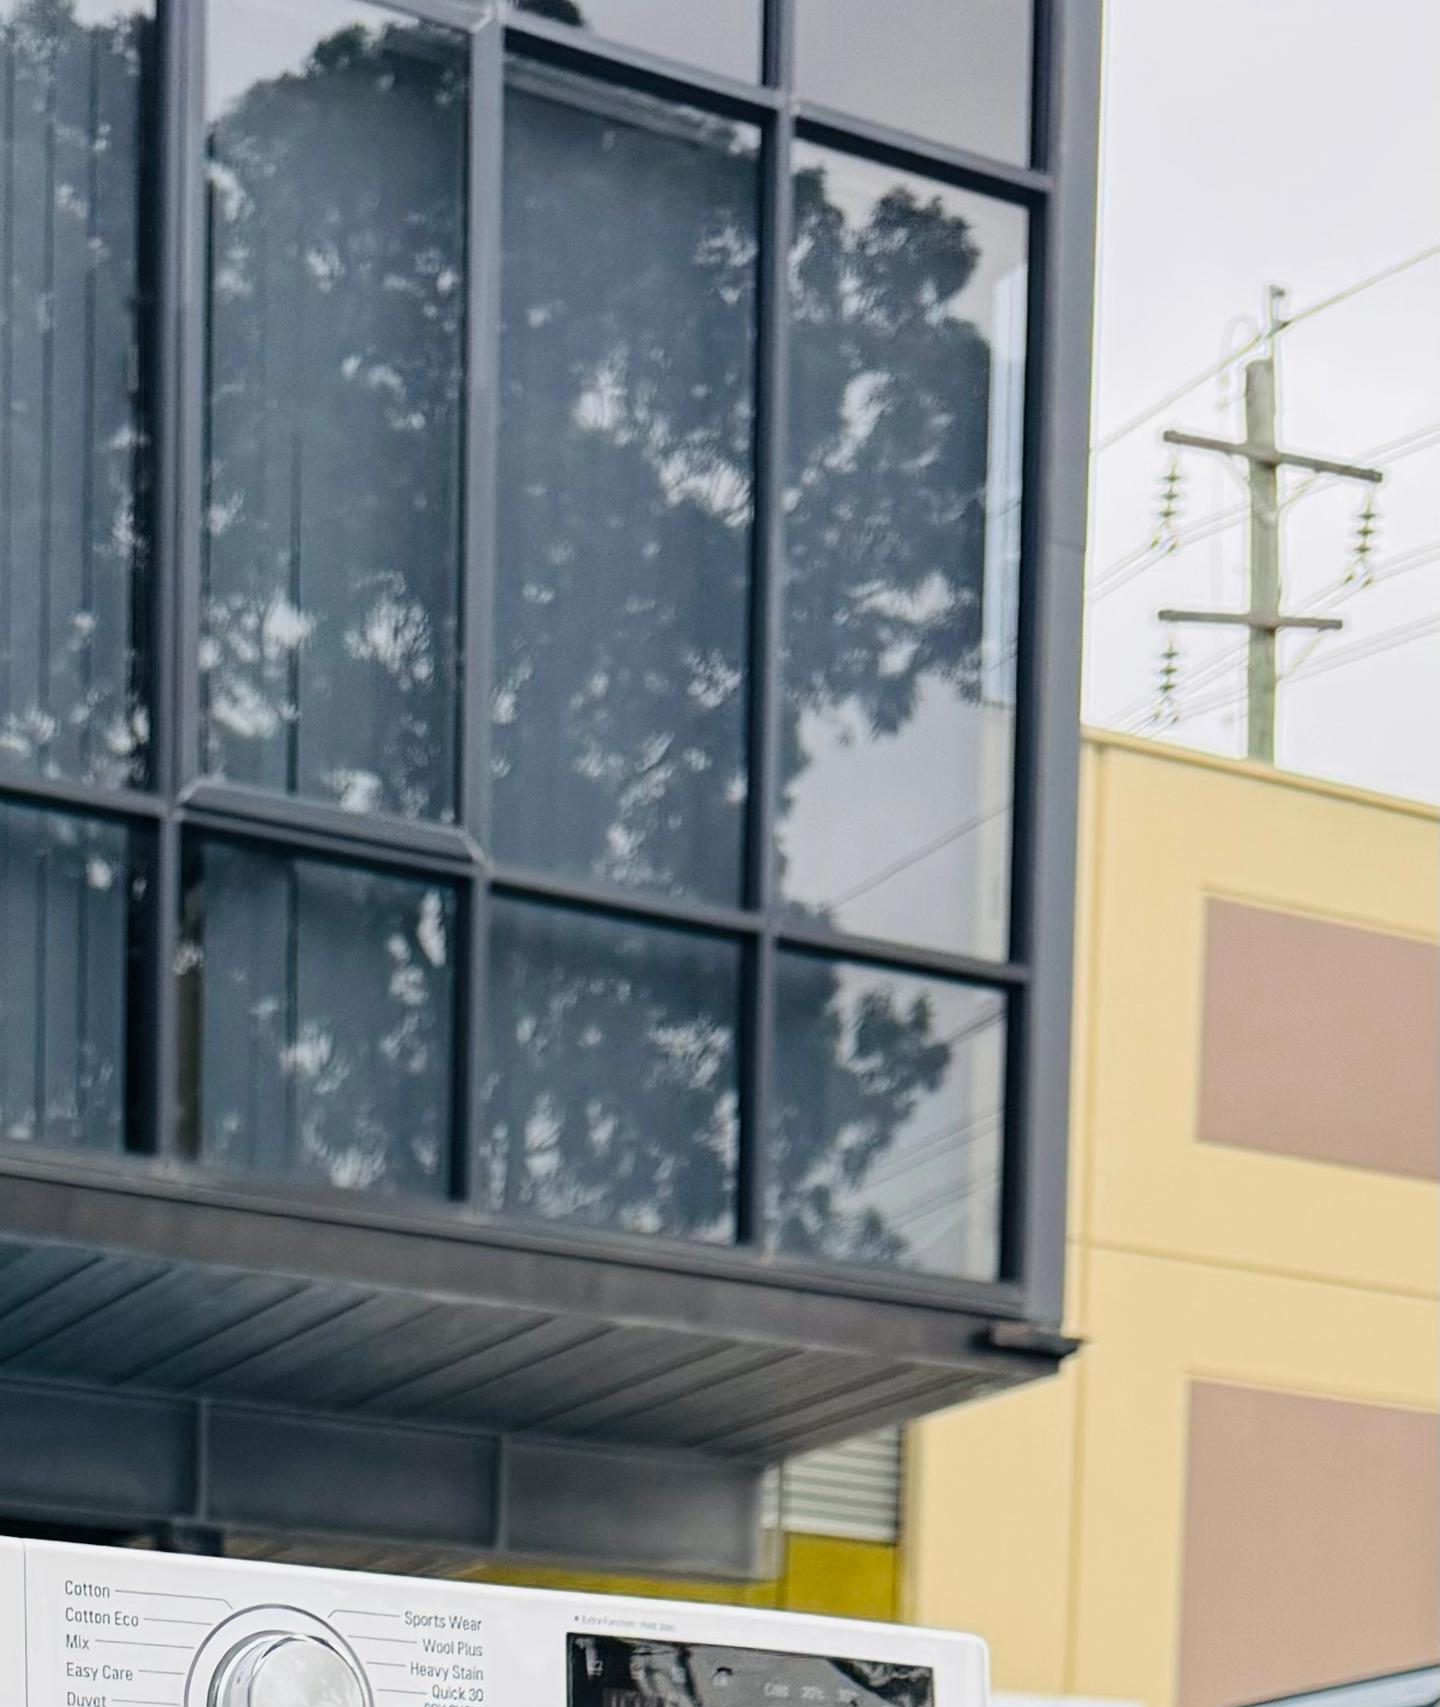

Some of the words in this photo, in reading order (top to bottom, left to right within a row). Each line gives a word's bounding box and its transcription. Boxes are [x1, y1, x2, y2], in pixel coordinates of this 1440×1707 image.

[65, 1580, 110, 1598] Cotton
[65, 1607, 110, 1624] Cotton
[115, 1611, 139, 1627] Eco
[405, 1610, 446, 1628] Sports
[449, 1616, 482, 1631] Wear
[66, 1634, 89, 1650] Mix
[423, 1638, 454, 1654] Wool
[458, 1641, 483, 1656] Plus
[66, 1661, 98, 1681] Easy
[102, 1665, 133, 1681] Care
[410, 1662, 449, 1681] Heavy
[453, 1665, 484, 1680] Stain
[432, 1684, 466, 1700] Quick
[469, 1688, 484, 1702] 30
